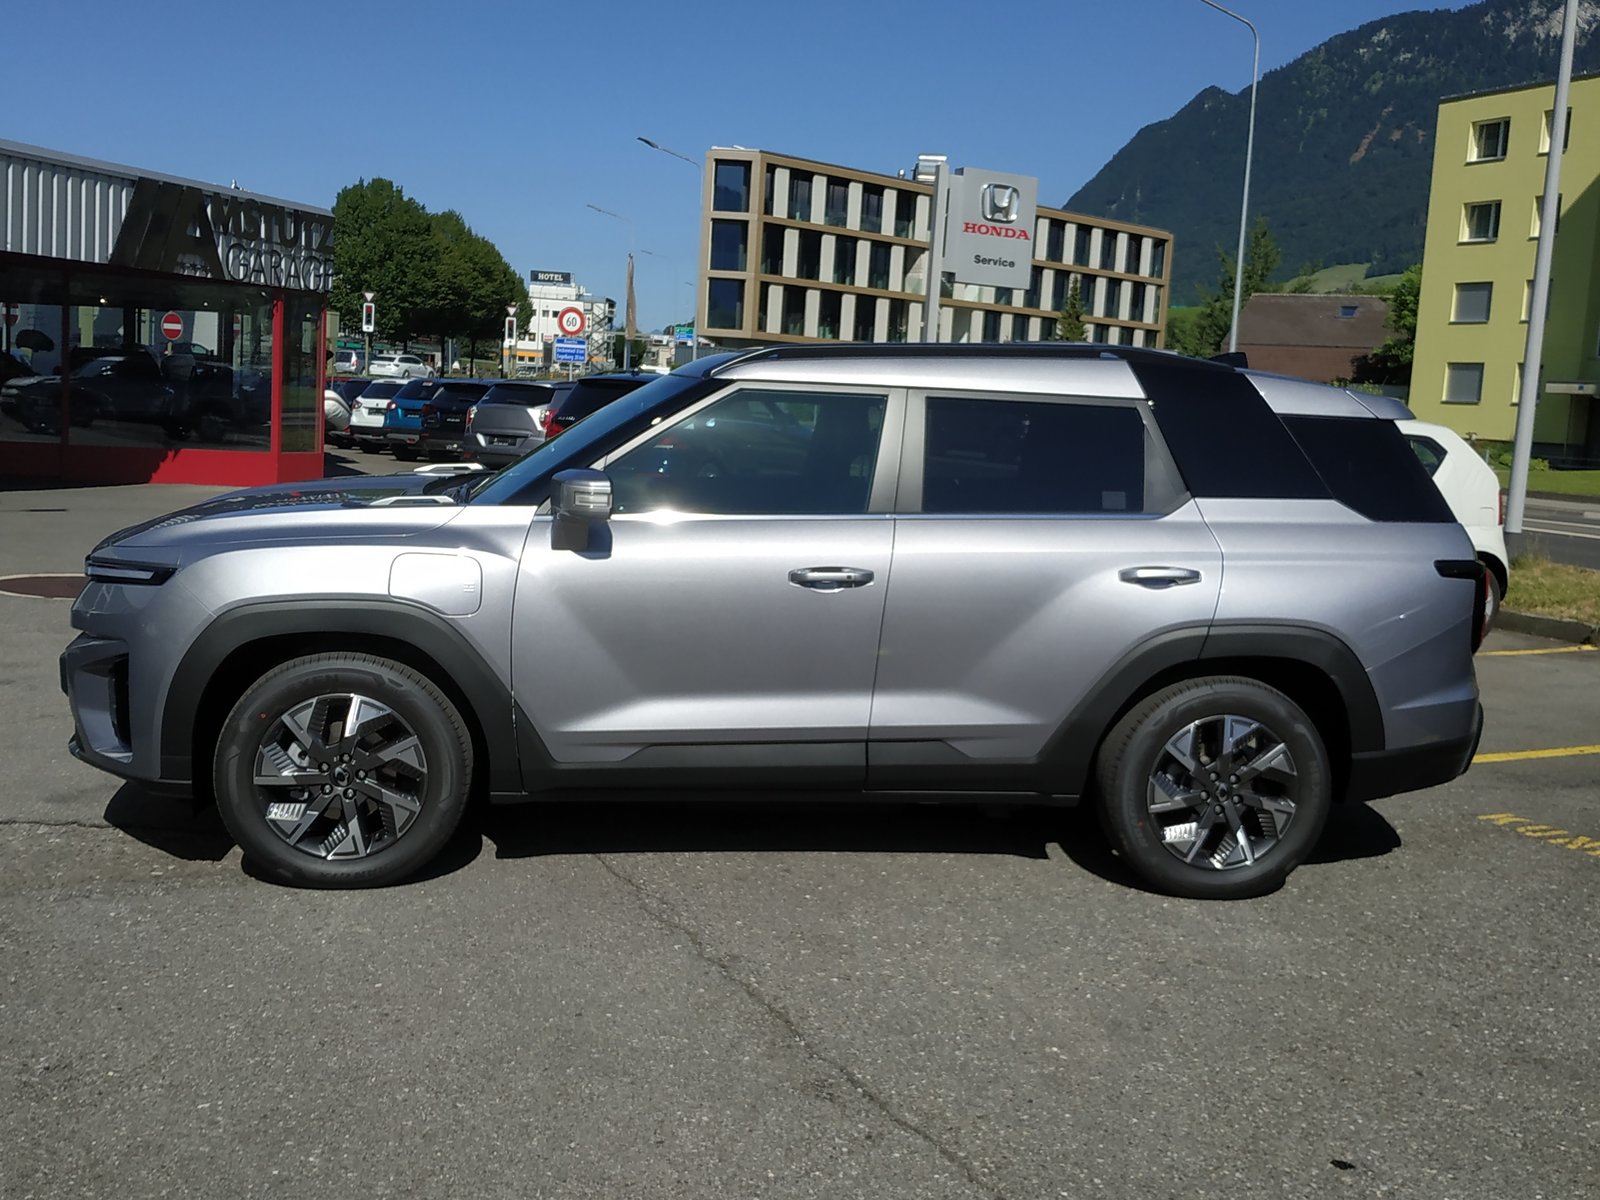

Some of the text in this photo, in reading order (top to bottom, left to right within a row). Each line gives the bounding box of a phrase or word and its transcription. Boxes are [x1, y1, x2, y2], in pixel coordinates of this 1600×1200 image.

[963, 222, 1030, 240] HONDA
[973, 254, 1016, 268] Service
[226, 243, 334, 294] GARAGE
[538, 272, 563, 281] HOTEL
[566, 316, 577, 327] 60
